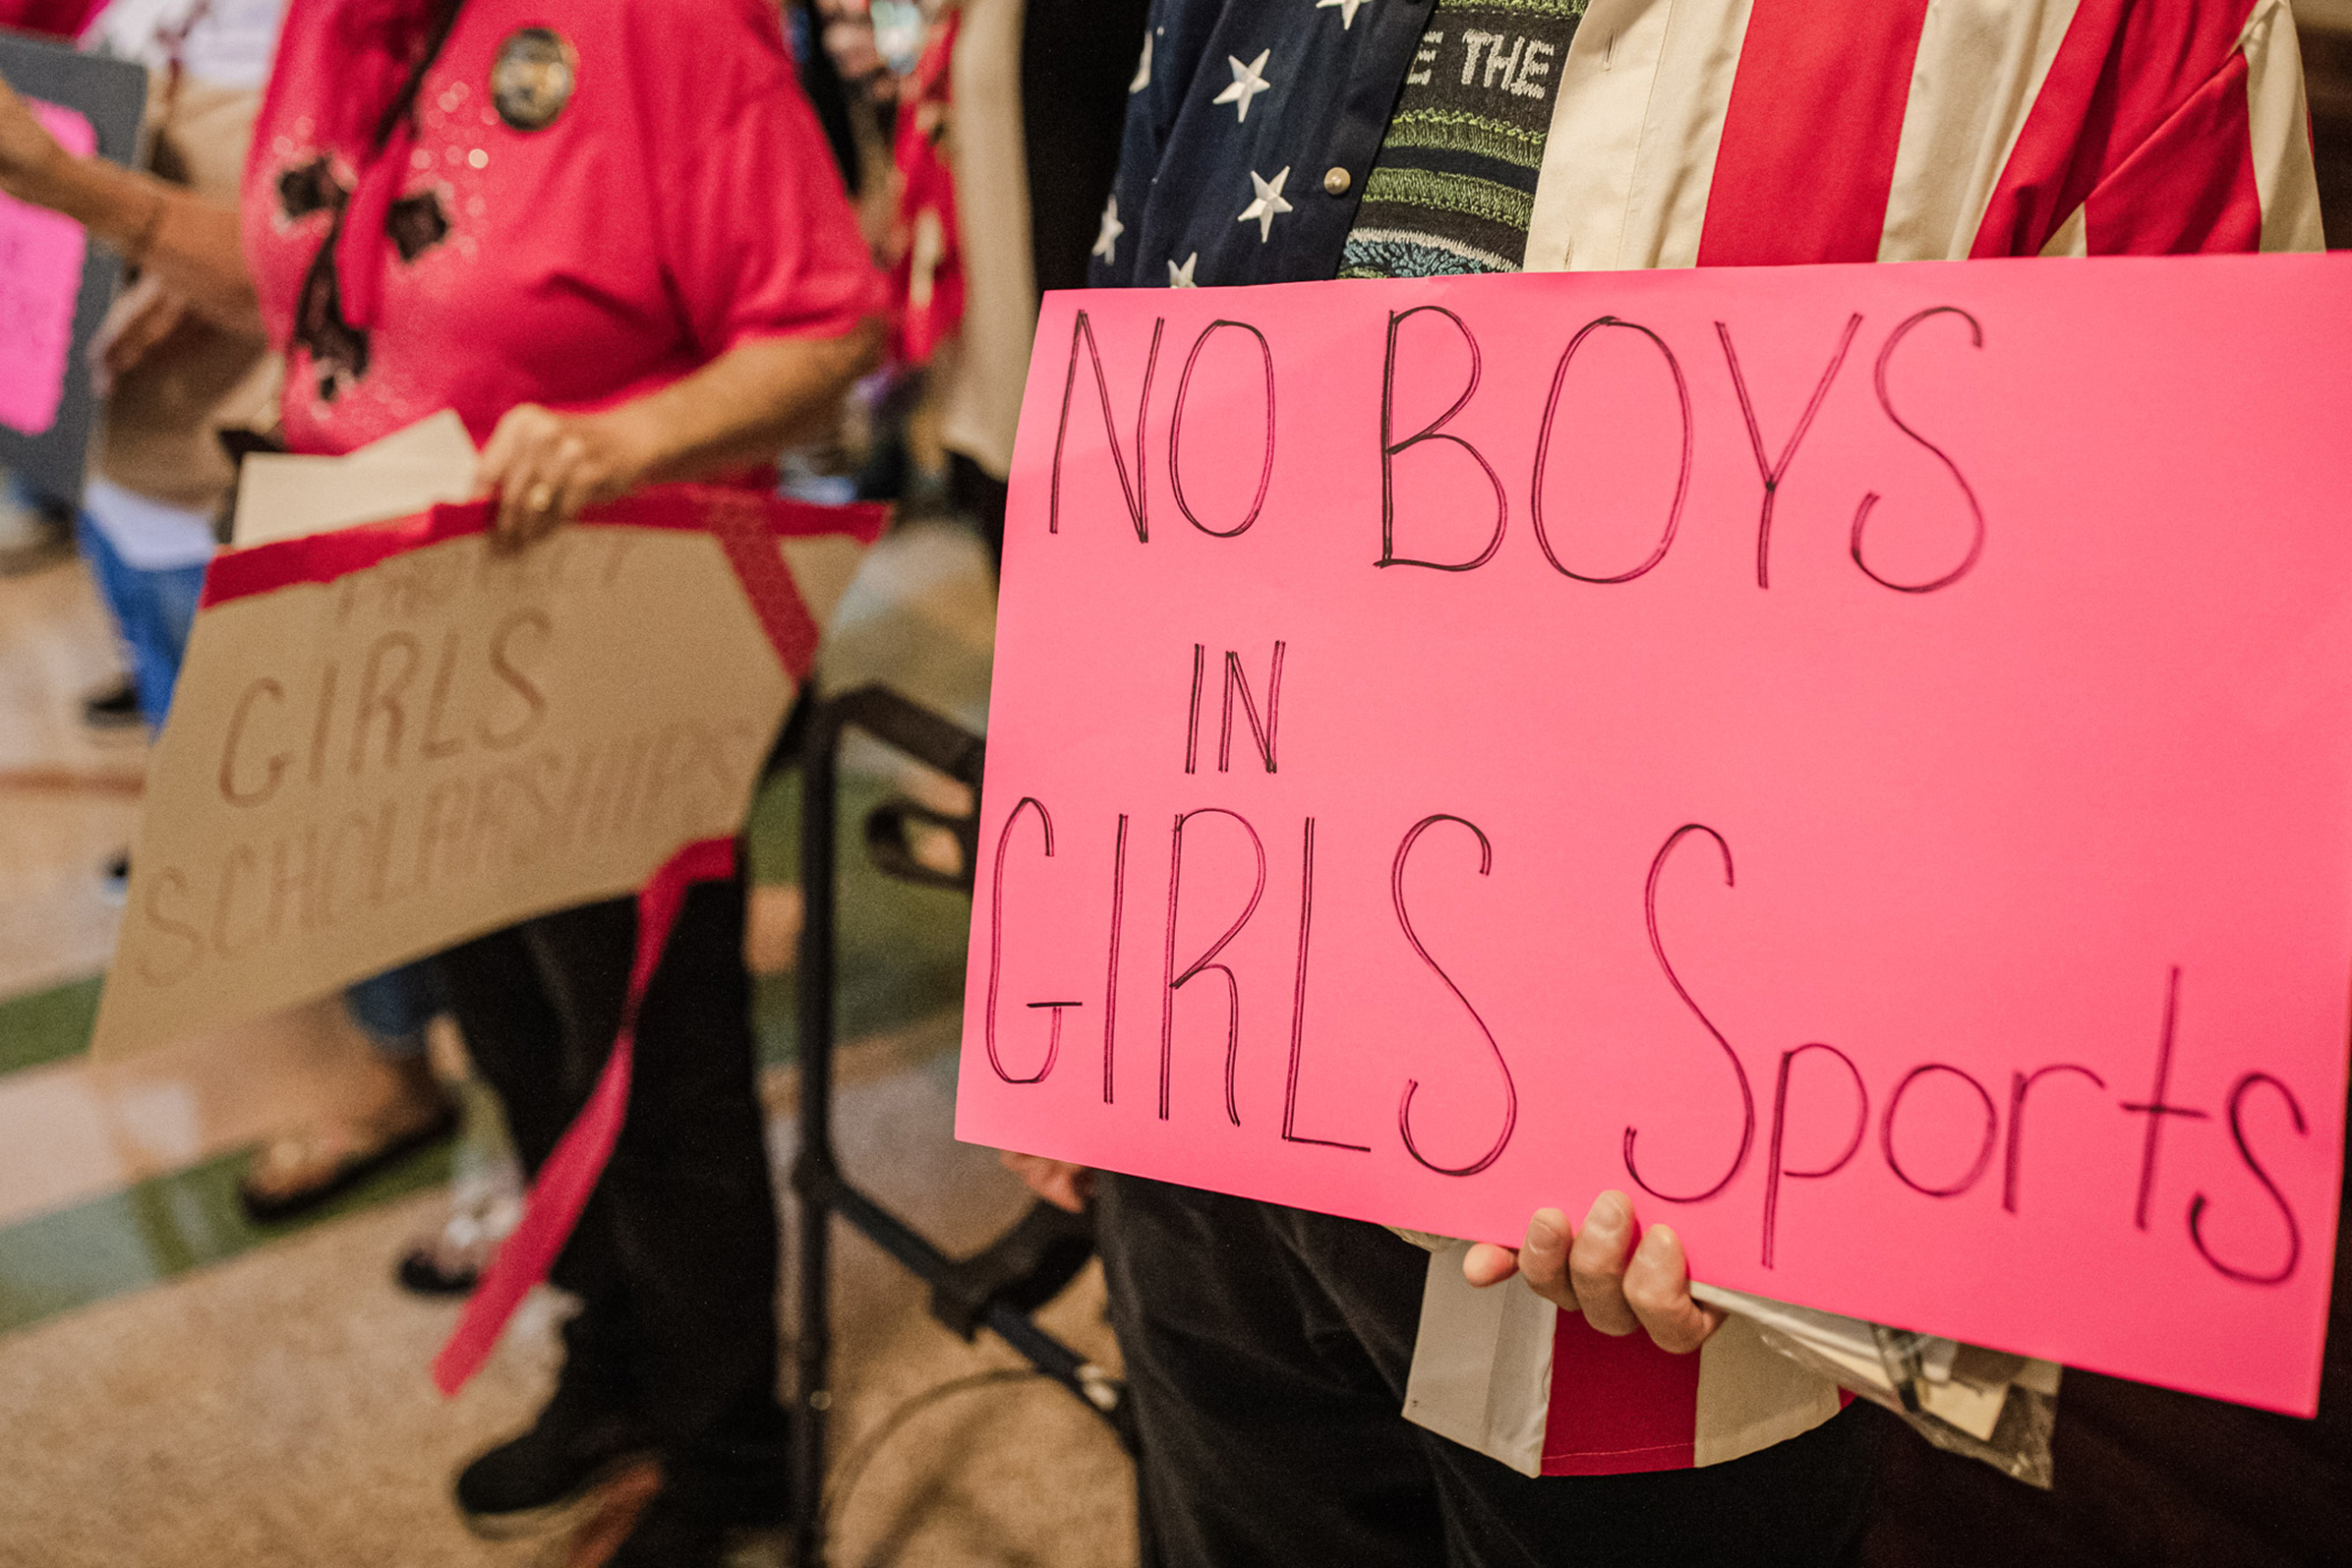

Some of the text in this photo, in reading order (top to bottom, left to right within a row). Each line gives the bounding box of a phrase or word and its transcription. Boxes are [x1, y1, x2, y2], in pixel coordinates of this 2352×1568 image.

[1461, 28, 1555, 99] THE
[1048, 305, 1984, 594] NO BOYS
[218, 606, 552, 807] GIRLS
[1184, 639, 1286, 775] IN
[986, 796, 2308, 1286] GIRLS Sports
